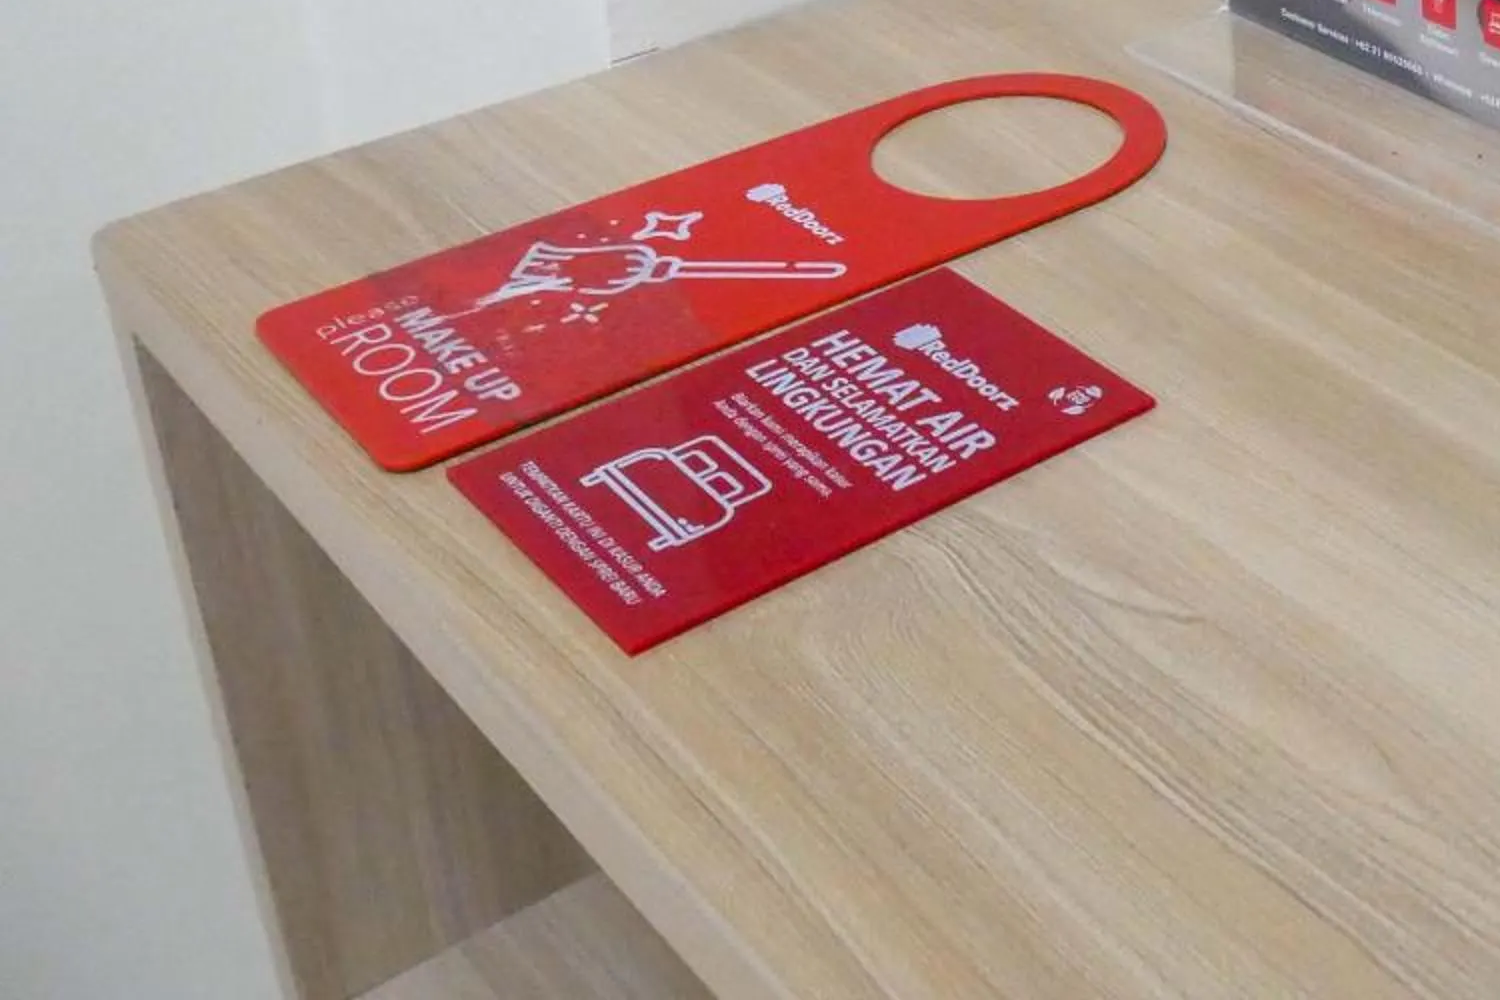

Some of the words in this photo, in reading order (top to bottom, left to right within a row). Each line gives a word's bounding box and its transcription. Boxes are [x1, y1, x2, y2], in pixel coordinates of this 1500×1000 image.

[771, 194, 844, 245] RedDoorz
[330, 323, 477, 434] ROOM
[393, 307, 488, 374] MAKE
[464, 368, 521, 400] UP
[810, 329, 942, 412] HEMAT
[915, 411, 996, 460] AIR
[917, 339, 1020, 411] RedDoorz
[745, 359, 927, 491] LINGKUNGAN
[782, 347, 836, 382] DAN
[821, 376, 957, 474] SELAMATKAN
